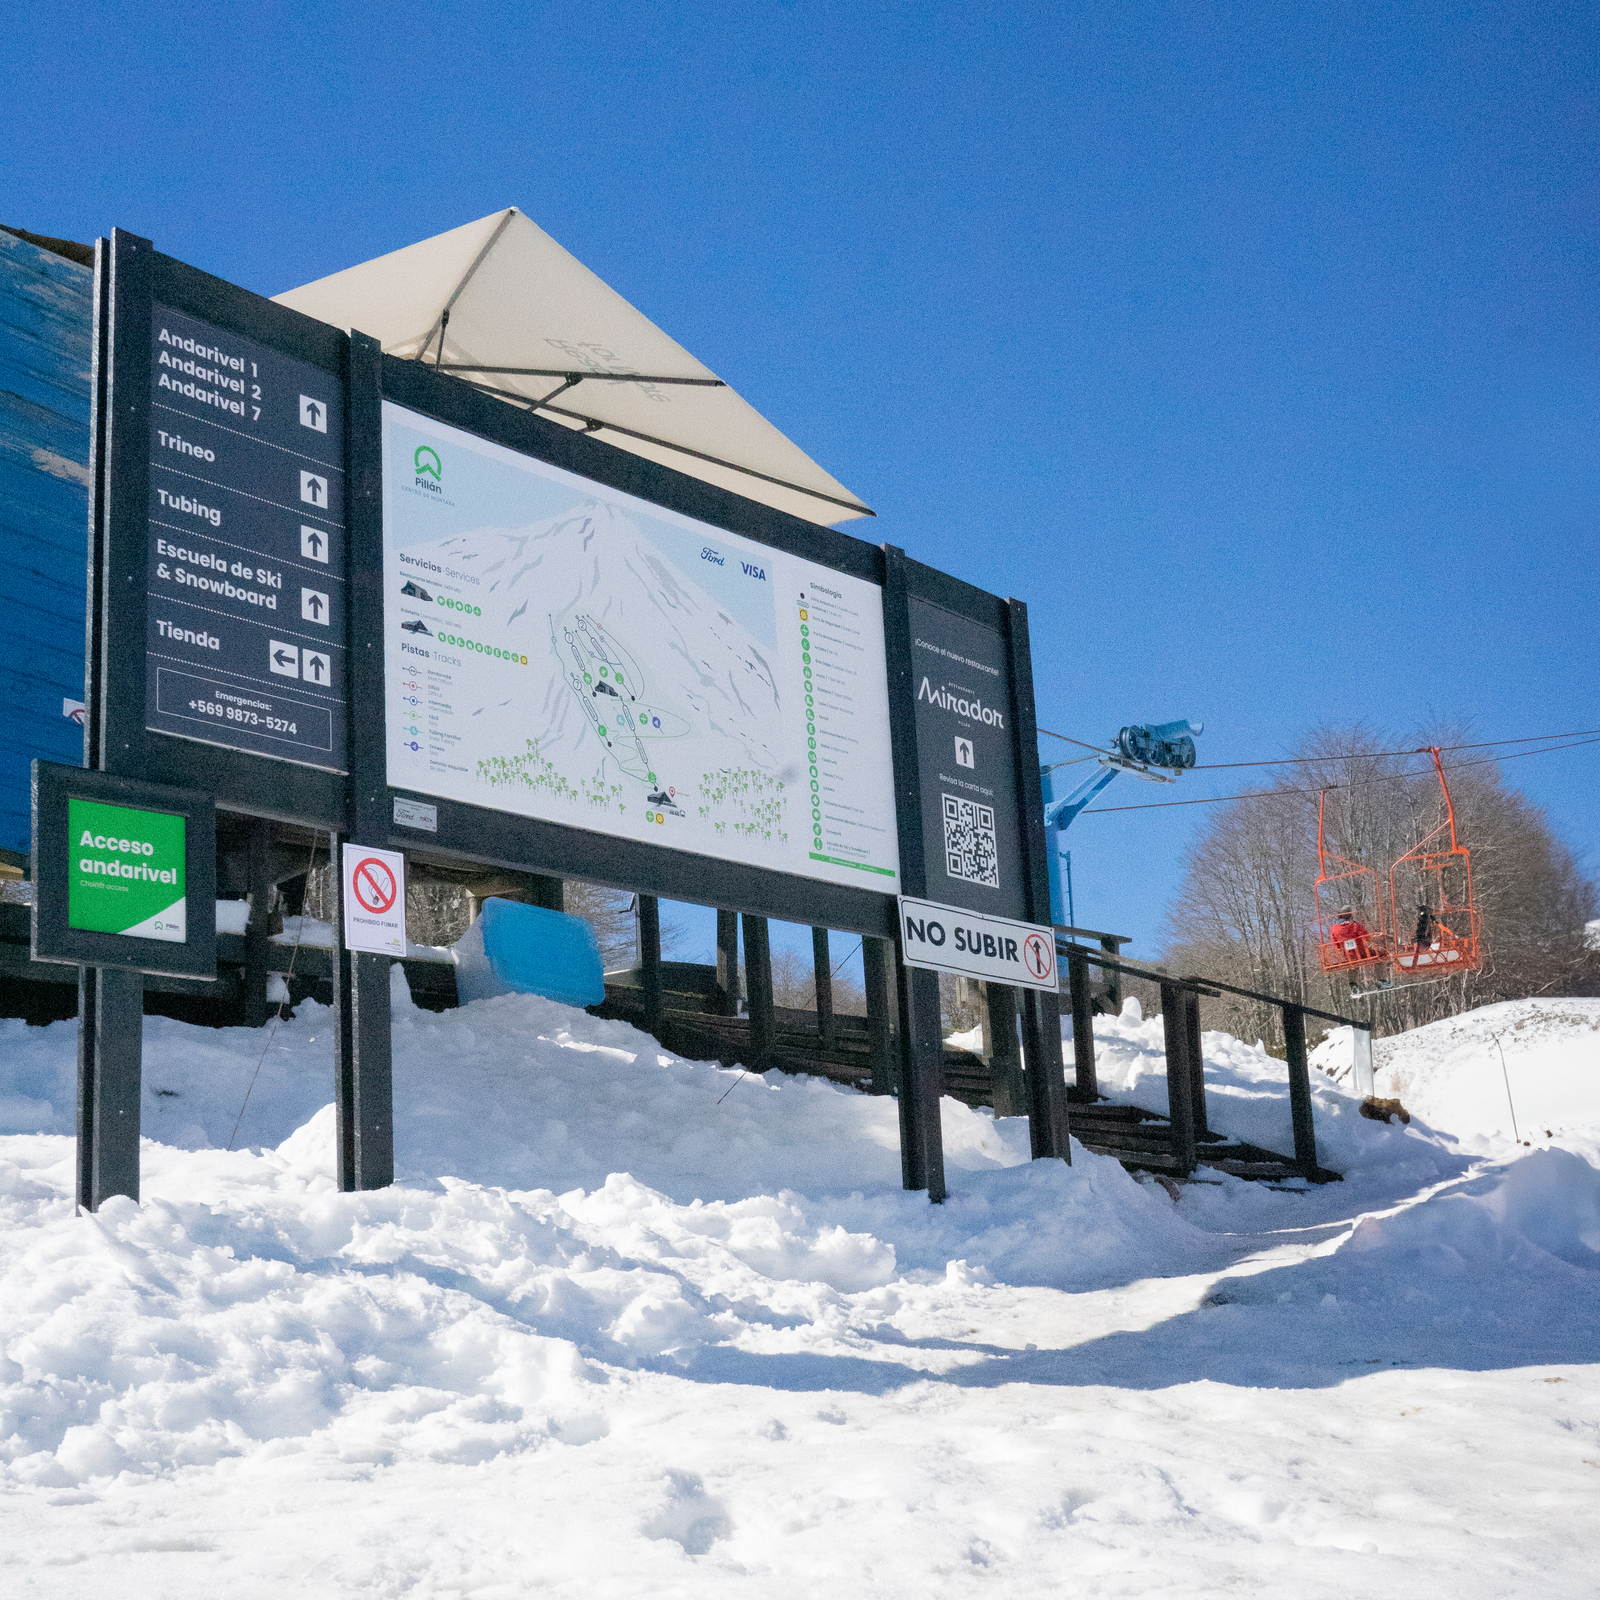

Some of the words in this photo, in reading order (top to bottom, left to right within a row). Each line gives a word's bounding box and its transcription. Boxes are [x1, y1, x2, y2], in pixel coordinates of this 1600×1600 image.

[159, 328, 244, 372] Andarivel
[252, 363, 258, 377] 1
[159, 351, 244, 394] Andarivel
[252, 385, 261, 400] 2
[159, 373, 244, 416] Andarivel
[252, 406, 261, 421] 7
[158, 430, 215, 462] Trineo
[415, 477, 442, 494] Pillán
[158, 489, 221, 526] Tubing
[157, 539, 227, 572] Escuela
[231, 562, 252, 579] de
[257, 568, 281, 589] Ski
[400, 553, 442, 573] Servicios
[445, 567, 480, 585] Services
[701, 547, 724, 566] Ford
[739, 561, 766, 581] VISA
[157, 563, 171, 580] &
[175, 567, 276, 610] Snowboard
[157, 620, 220, 650] Tienda
[401, 643, 429, 658] Pistas
[433, 651, 461, 667] Tracks
[947, 651, 964, 663] nuevo
[215, 690, 272, 711] Emergencias:
[918, 676, 1004, 729] Mirador
[189, 700, 223, 717] +569
[226, 707, 297, 735] 9873-5274
[940, 773, 957, 785] Revisa
[965, 782, 979, 792] carta
[396, 808, 414, 821] Ford
[79, 830, 153, 856] Acceso
[79, 859, 177, 885] andarivel
[353, 917, 380, 926] PROHIBIDO
[381, 920, 398, 929] FUMAR
[906, 916, 945, 946] NO
[955, 927, 1020, 962] SUBIR
